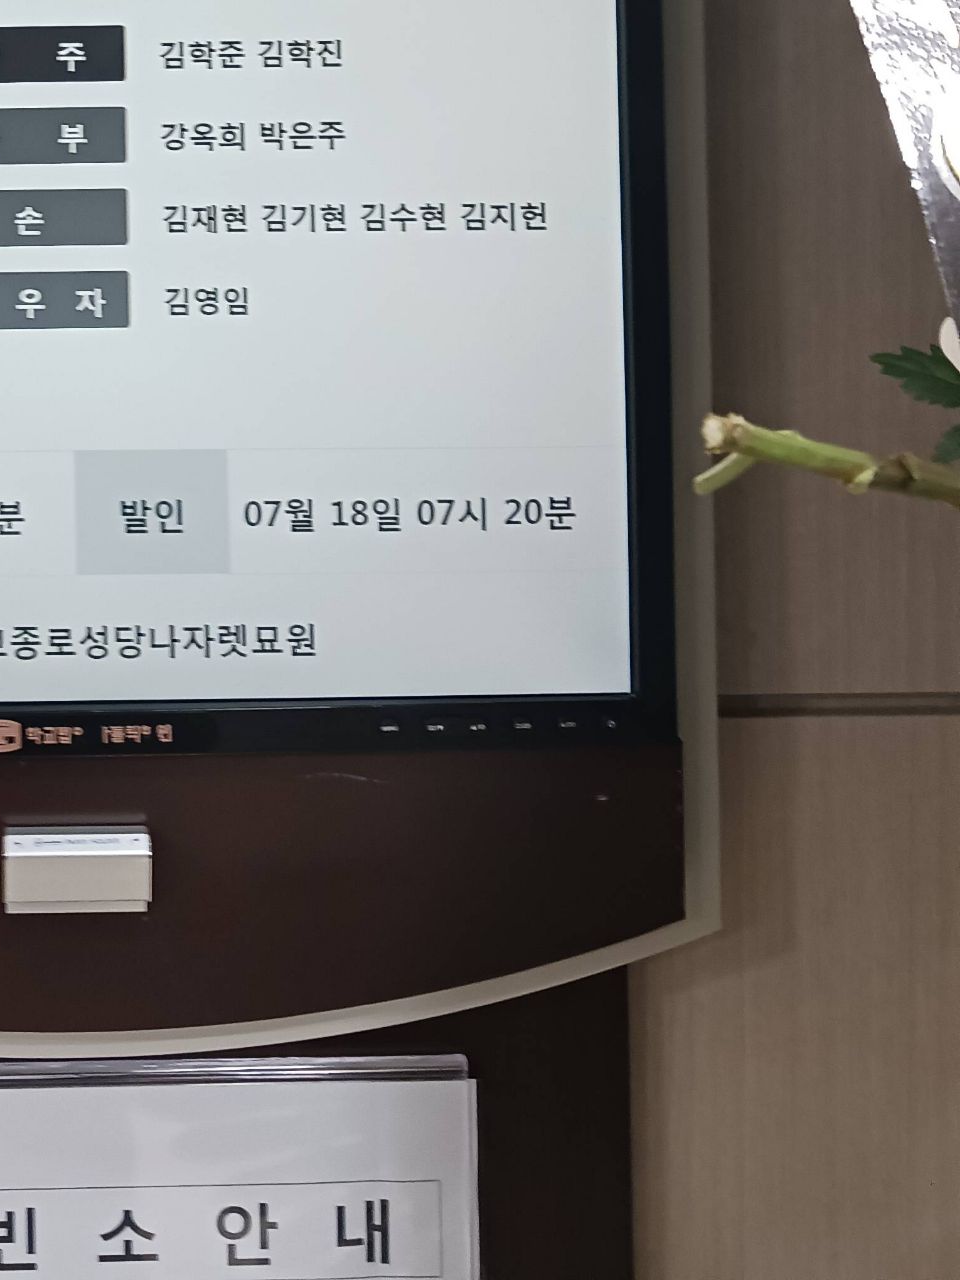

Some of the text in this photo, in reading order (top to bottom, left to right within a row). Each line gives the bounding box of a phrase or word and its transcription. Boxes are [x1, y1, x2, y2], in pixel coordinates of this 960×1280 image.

[159, 39, 343, 70] 김학준 김학진
[160, 121, 347, 152] 강옥희 박은주
[13, 206, 45, 236] 손
[162, 201, 548, 234] 김재현 김기현 김수현 김지헌
[164, 286, 249, 316] 김영임
[120, 499, 184, 534] 발인
[244, 496, 577, 533] 07월 18일 07시 20분
